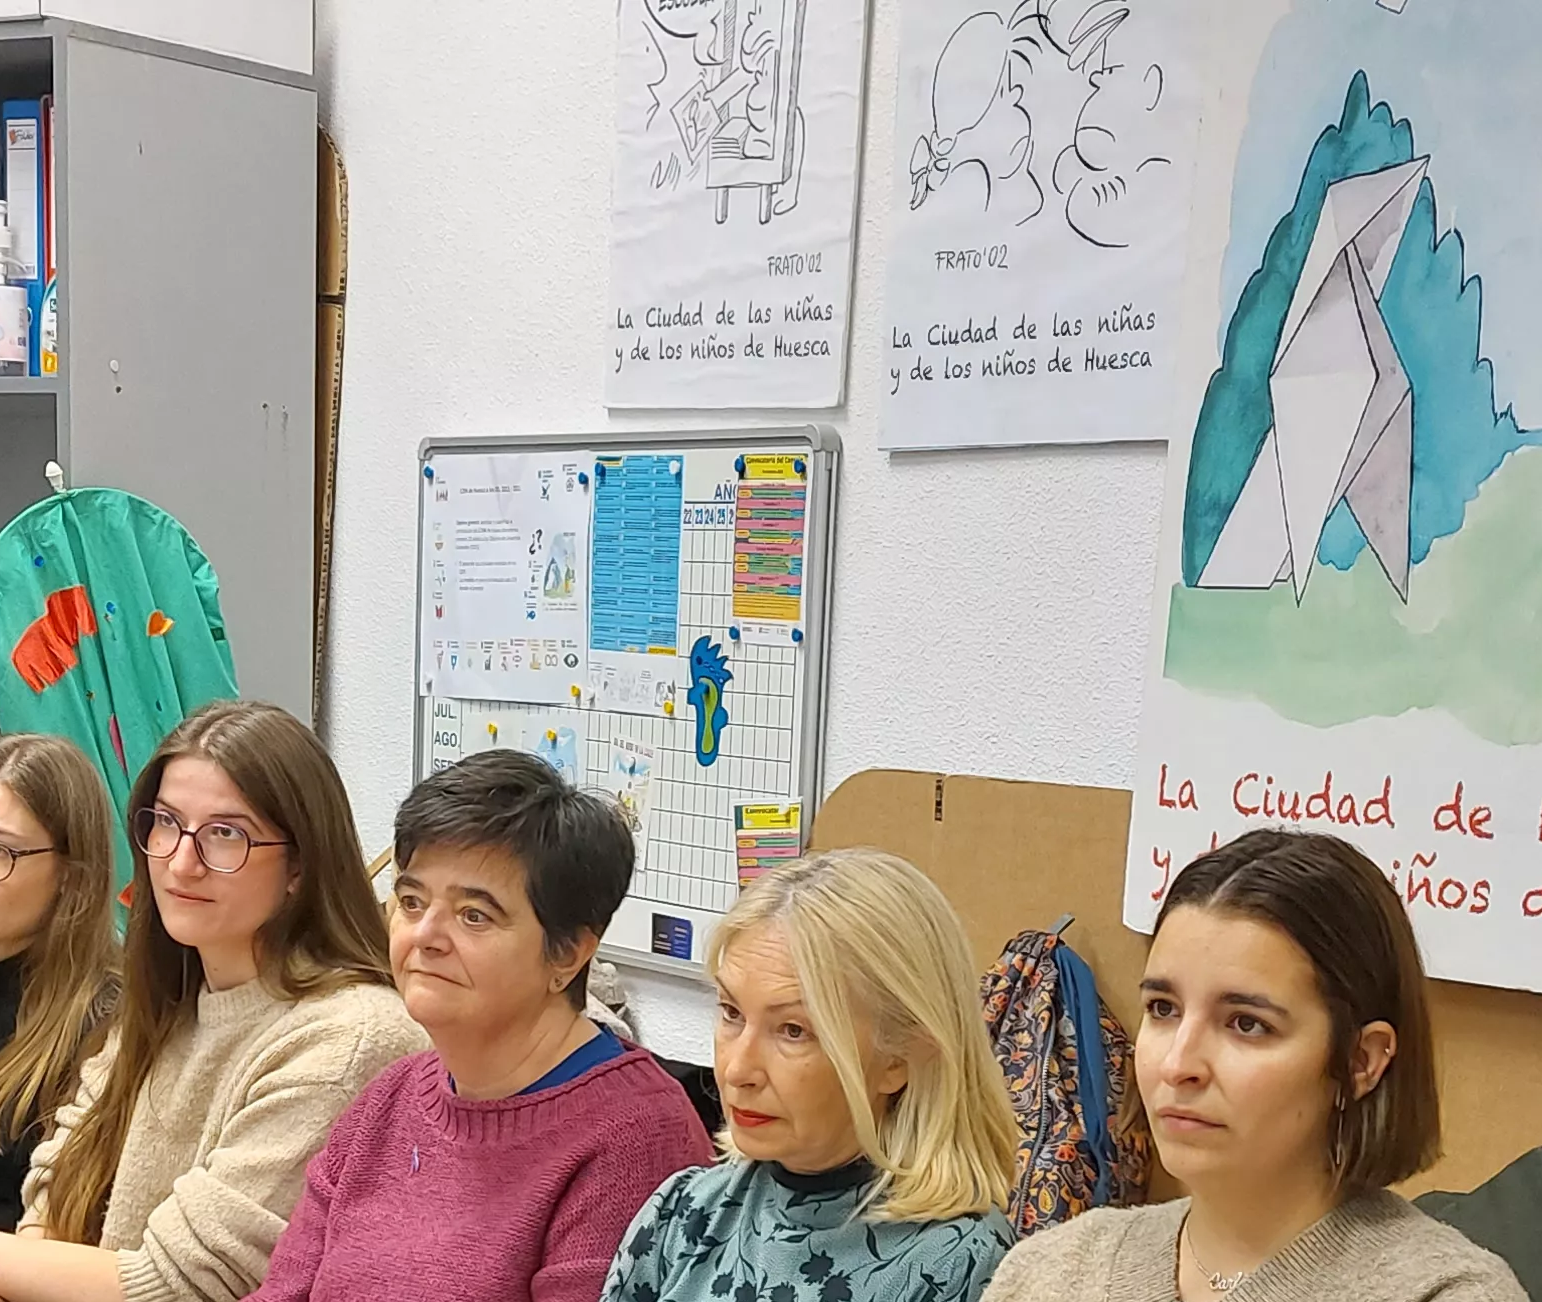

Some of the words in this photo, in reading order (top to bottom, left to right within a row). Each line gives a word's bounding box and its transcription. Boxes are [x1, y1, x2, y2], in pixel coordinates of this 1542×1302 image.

[767, 251, 822, 277] FRATO'02
[935, 244, 1009, 271] FRATO'02
[617, 307, 634, 330] La
[646, 301, 704, 328] Ciudad
[715, 299, 735, 325] de
[748, 300, 772, 325] las
[784, 294, 833, 323] niñas
[892, 326, 913, 349] La
[927, 315, 999, 347] Ciudad
[1012, 313, 1038, 340] de
[1052, 311, 1083, 338] las
[1097, 302, 1156, 334] niñas
[615, 344, 624, 374] y
[631, 335, 651, 361] de
[658, 337, 683, 361] los
[690, 333, 735, 360] niños
[743, 332, 765, 359] de
[773, 336, 831, 358] Huesca
[890, 366, 901, 396] y
[909, 355, 934, 381] de
[943, 356, 972, 380] los
[981, 348, 1036, 377] niños
[1047, 345, 1073, 373] de
[1084, 350, 1153, 372] Huesca
[683, 508, 692, 524] 22
[705, 508, 714, 524] 24
[728, 508, 734, 524] 2
[434, 703, 457, 719] JUL.
[1158, 763, 1198, 811] La
[1233, 771, 1394, 828] Ciudad
[1433, 781, 1493, 839] de
